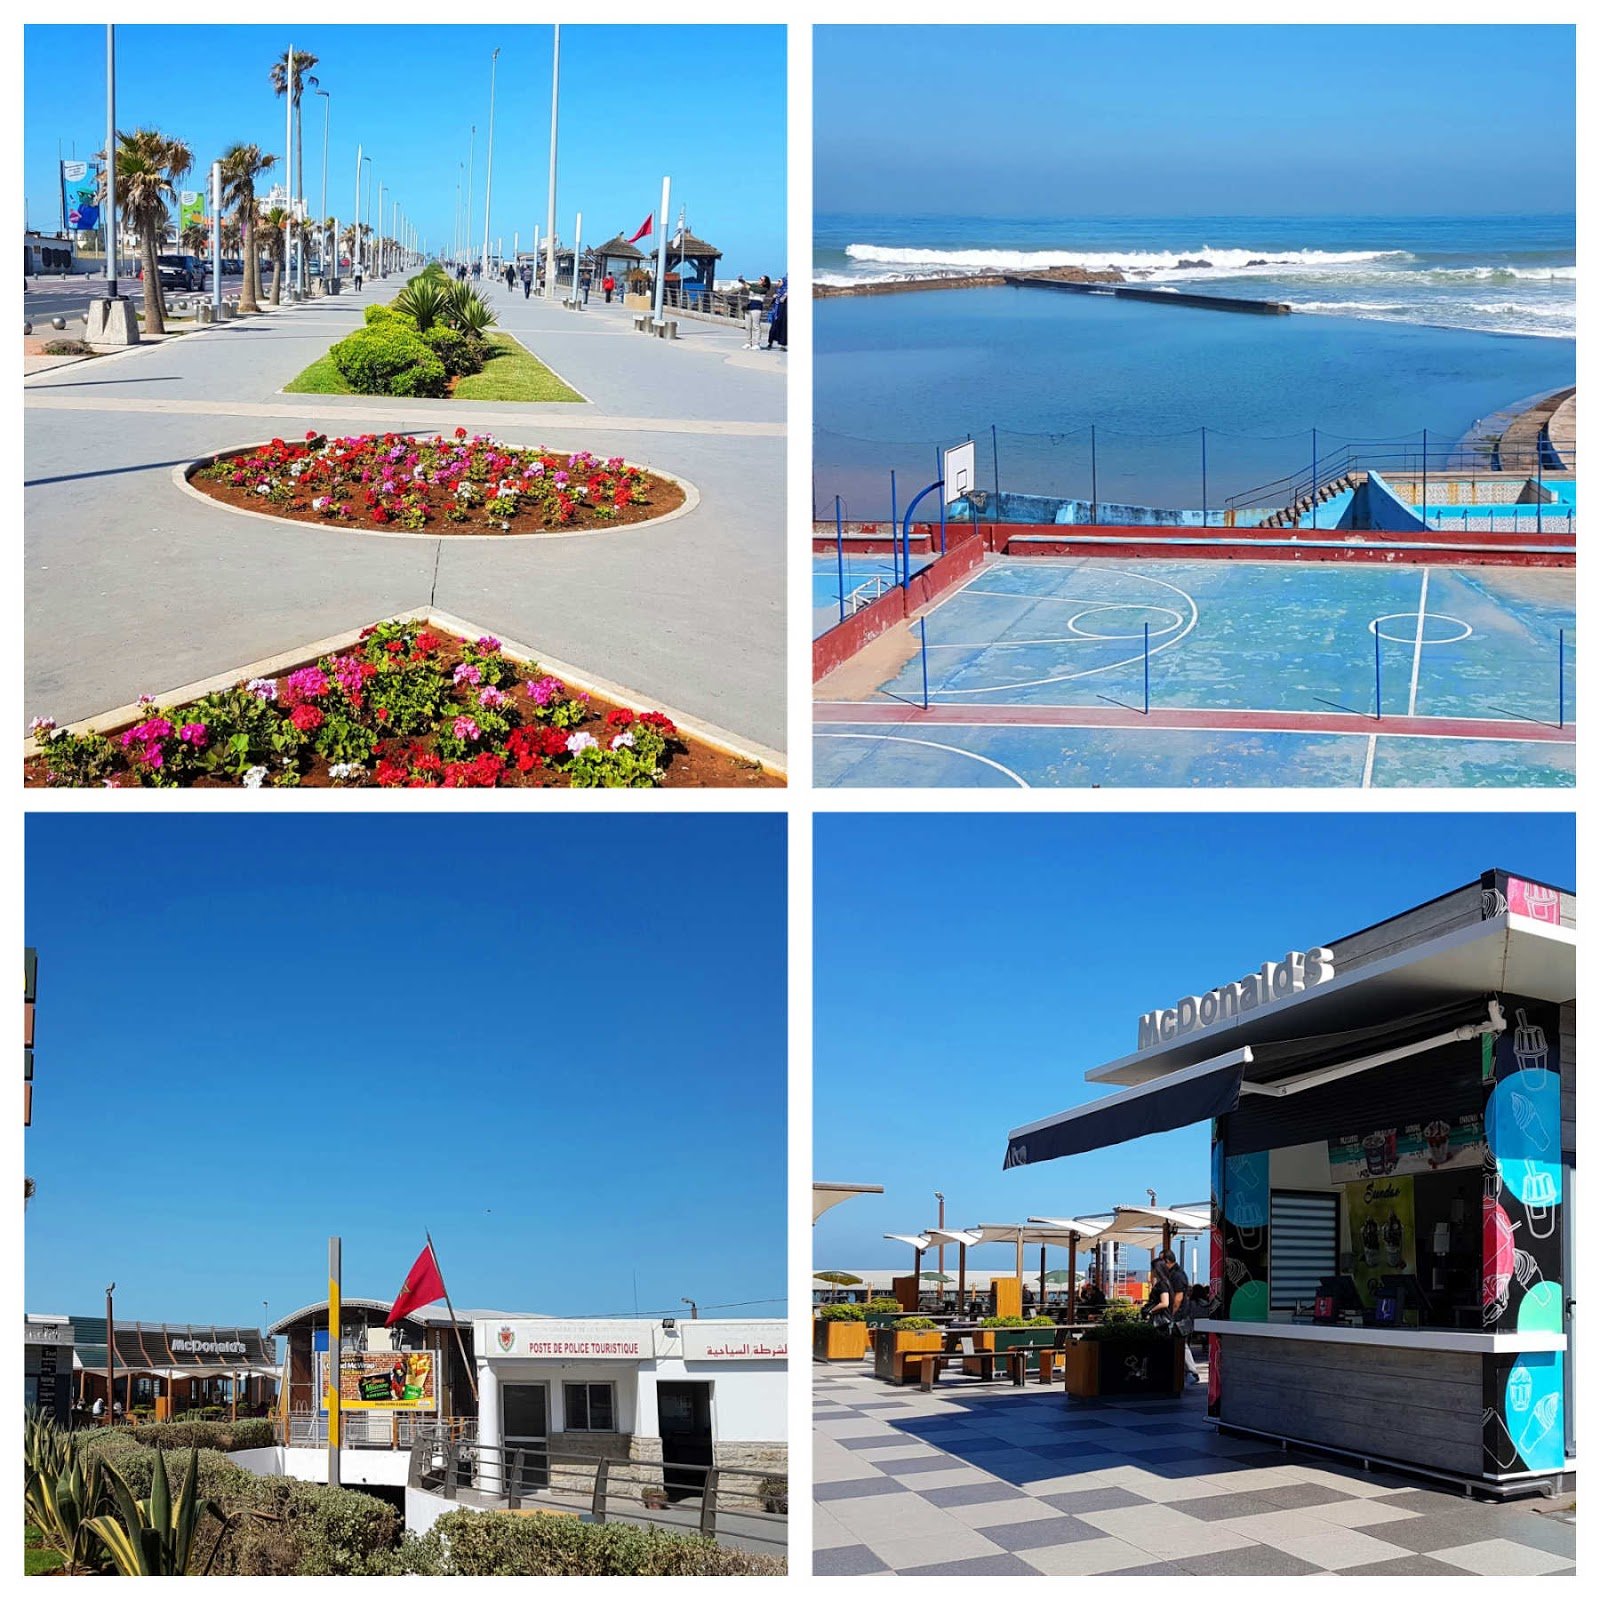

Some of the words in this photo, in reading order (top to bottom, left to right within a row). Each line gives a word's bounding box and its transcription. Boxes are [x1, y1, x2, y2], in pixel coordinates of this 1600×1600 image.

[1137, 946, 1335, 1051] McDonald's
[171, 1339, 247, 1354] McDonald's
[529, 1342, 552, 1354] POSTE
[553, 1342, 562, 1354] DE
[564, 1342, 589, 1354] POLICE
[591, 1342, 639, 1354] TOURISTIQUE
[753, 1343, 788, 1357] لشرطة
